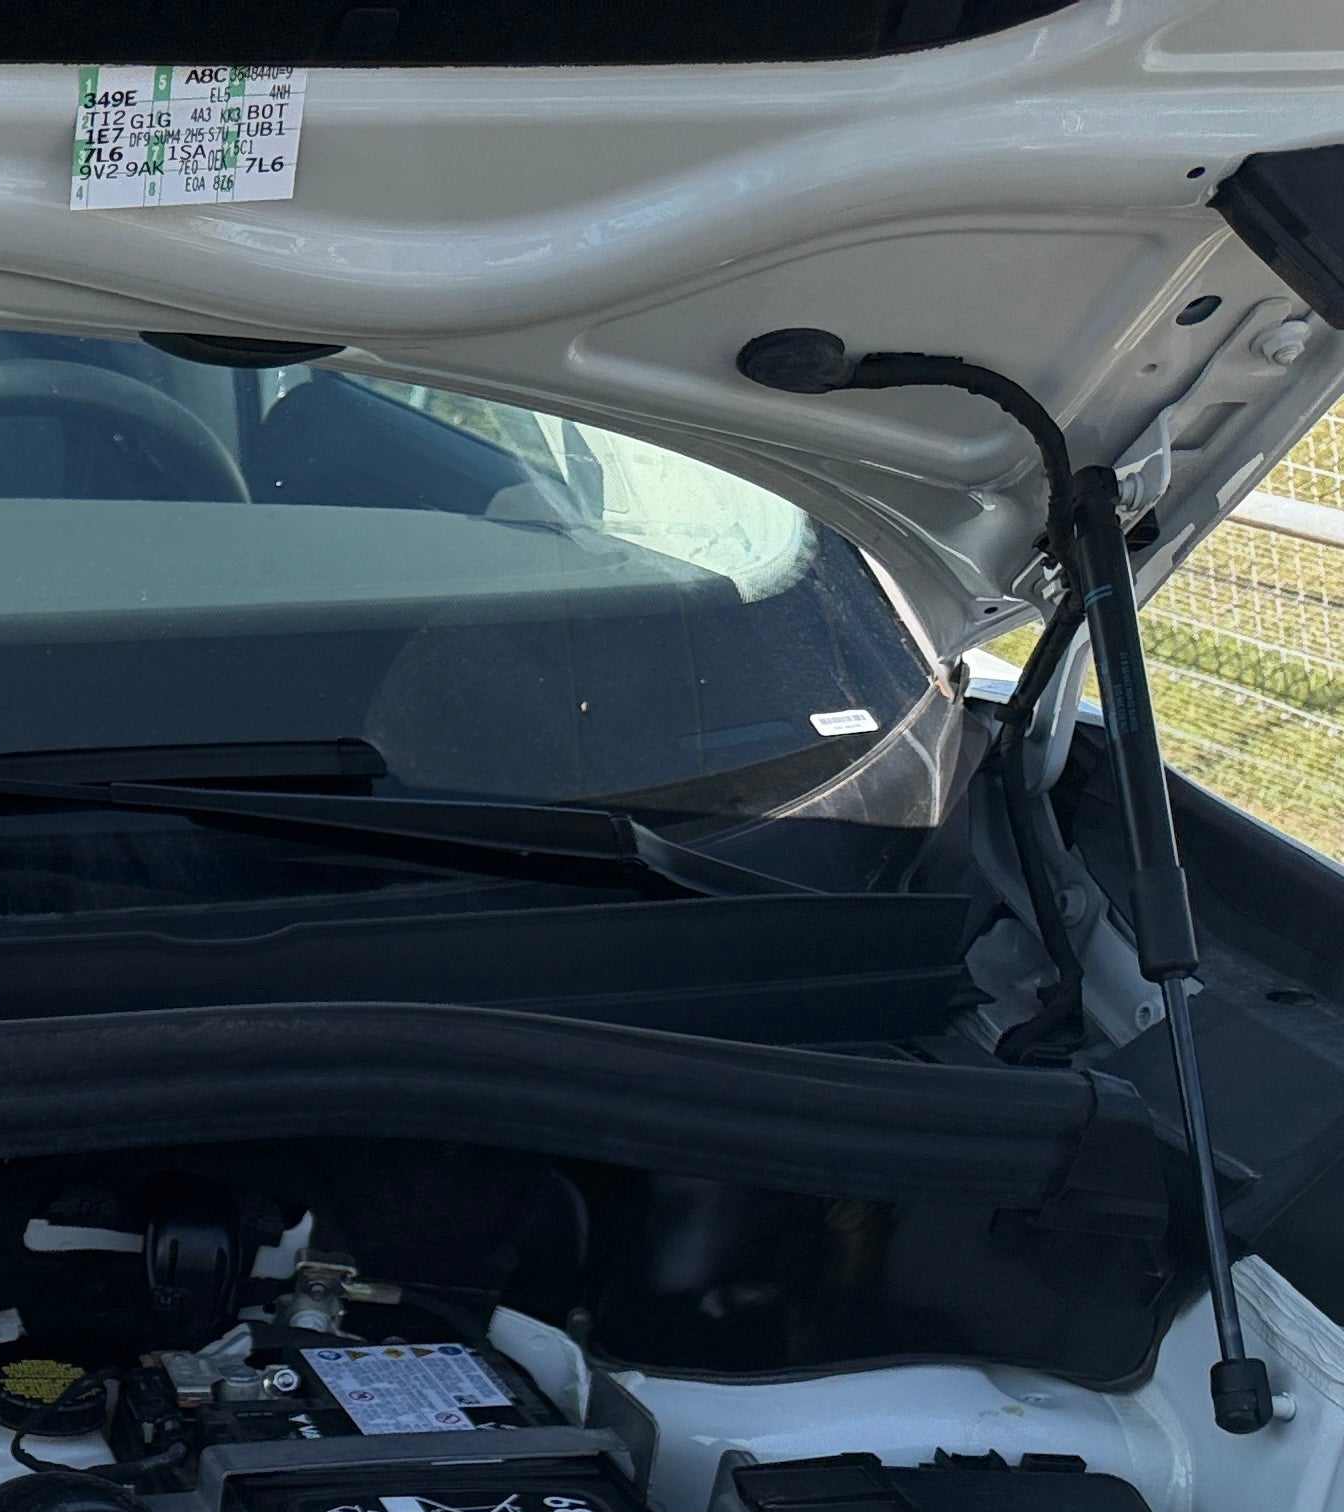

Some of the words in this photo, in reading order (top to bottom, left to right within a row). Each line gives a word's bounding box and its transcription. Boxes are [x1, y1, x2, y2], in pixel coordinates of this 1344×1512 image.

[83, 90, 138, 109] 349E
[83, 146, 124, 163] 7L6
[79, 163, 119, 180] 9V2
[125, 160, 165, 177] 9AK
[244, 156, 284, 174] 7L6
